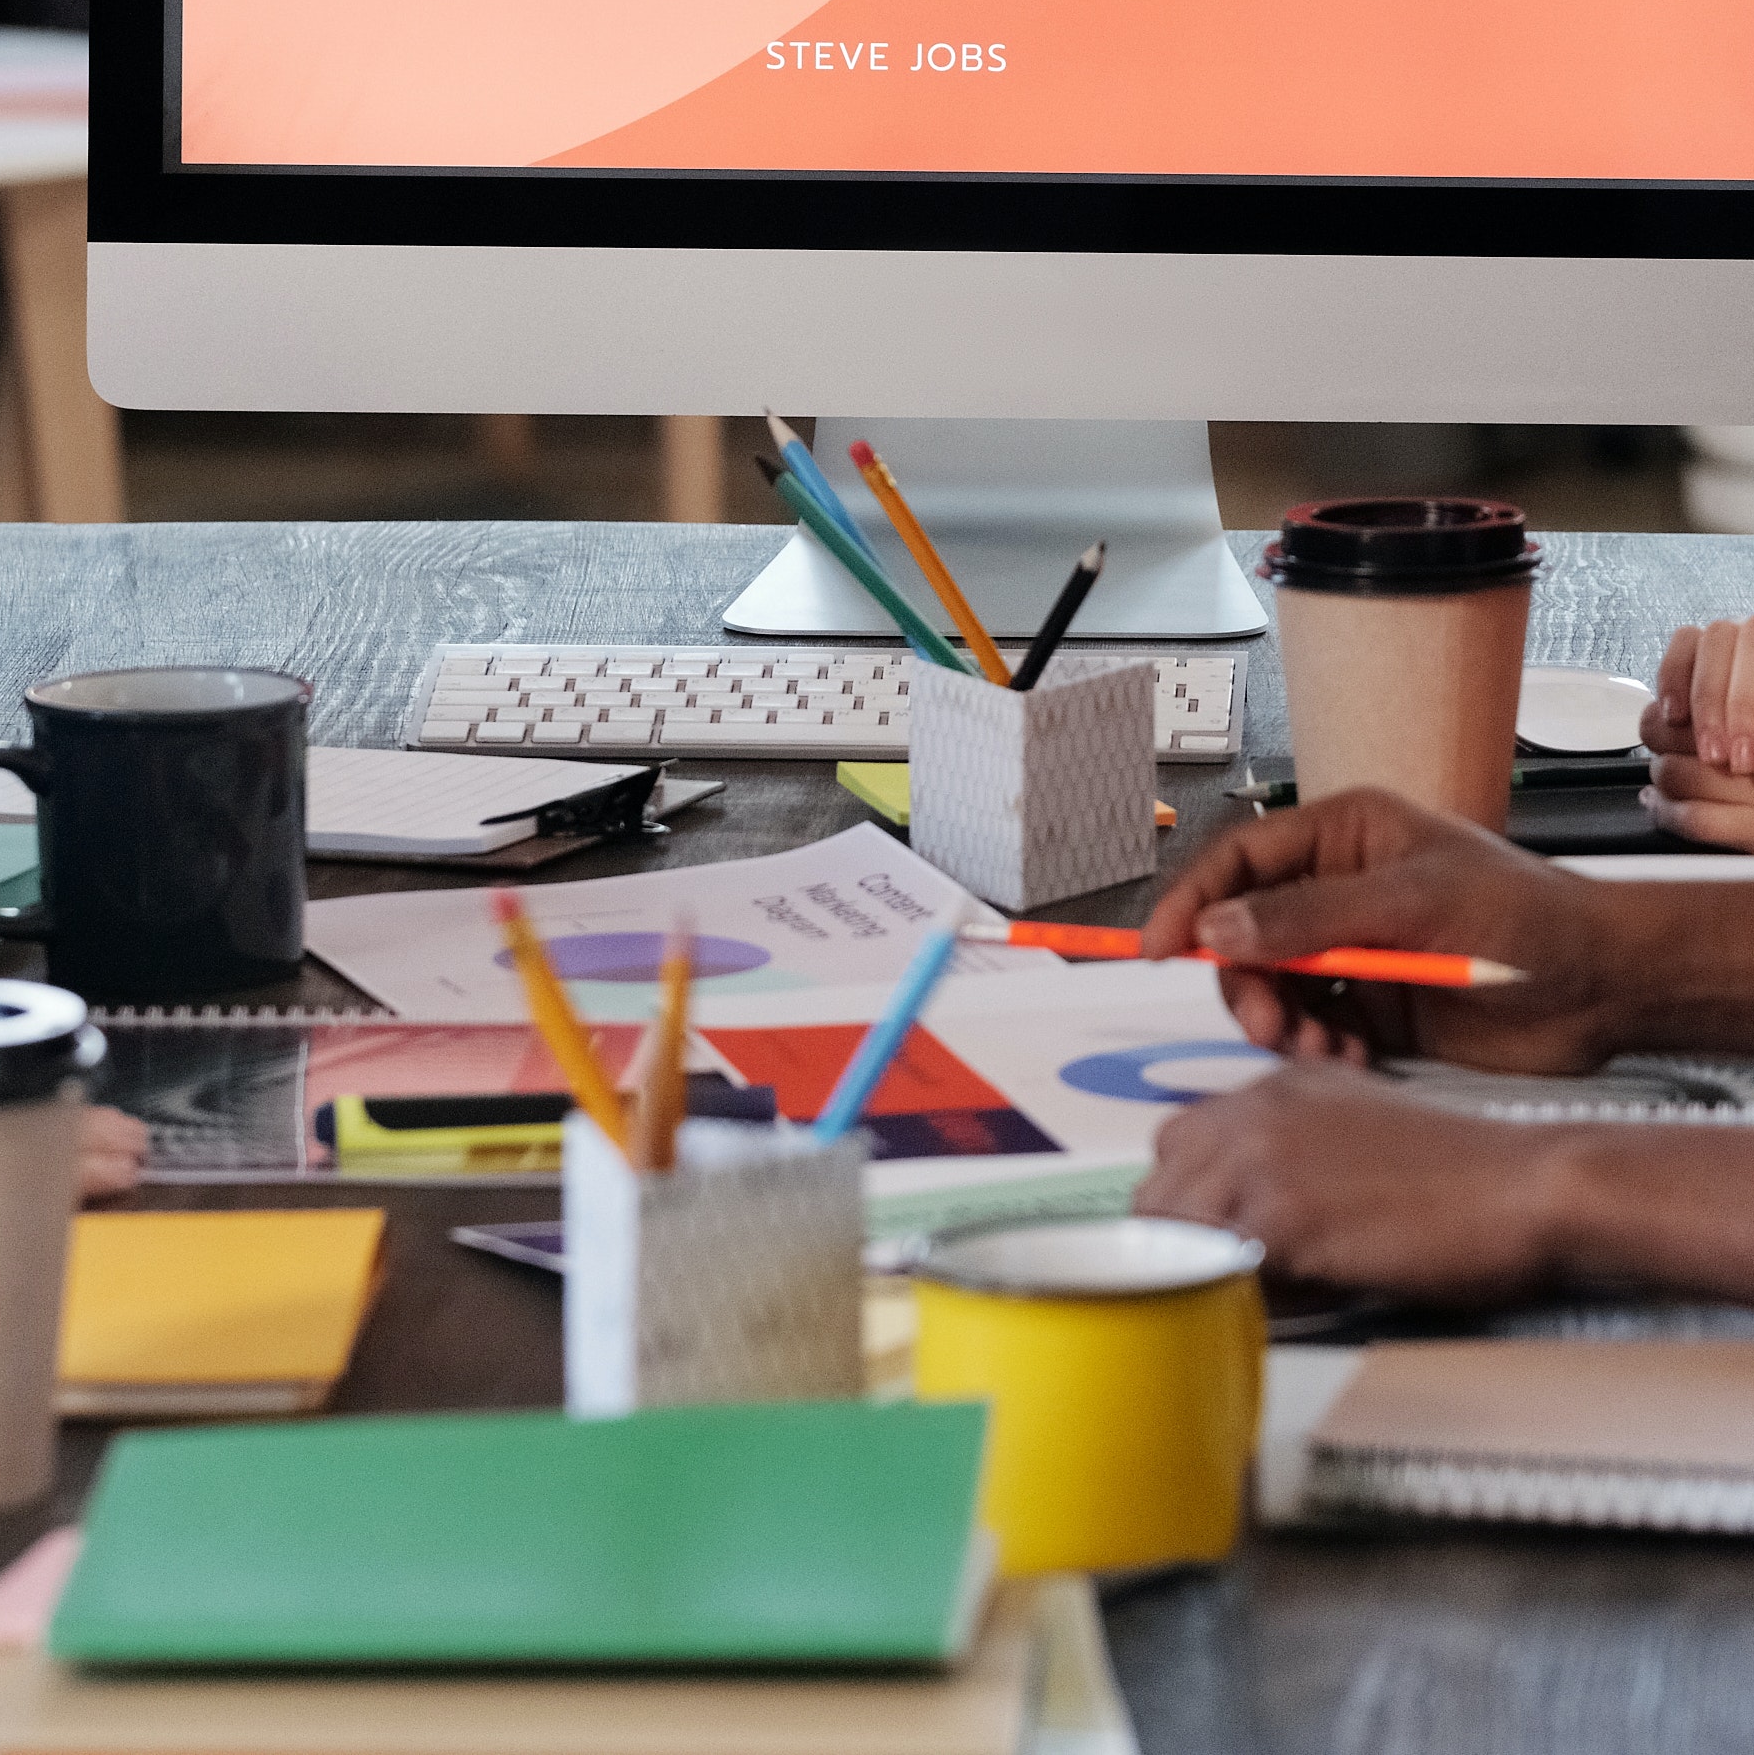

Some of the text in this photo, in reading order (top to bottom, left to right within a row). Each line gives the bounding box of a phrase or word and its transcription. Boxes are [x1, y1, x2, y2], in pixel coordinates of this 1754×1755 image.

[766, 41, 1009, 75] STEVE JOBS
[800, 881, 888, 939] Marketing
[857, 872, 935, 923] Content
